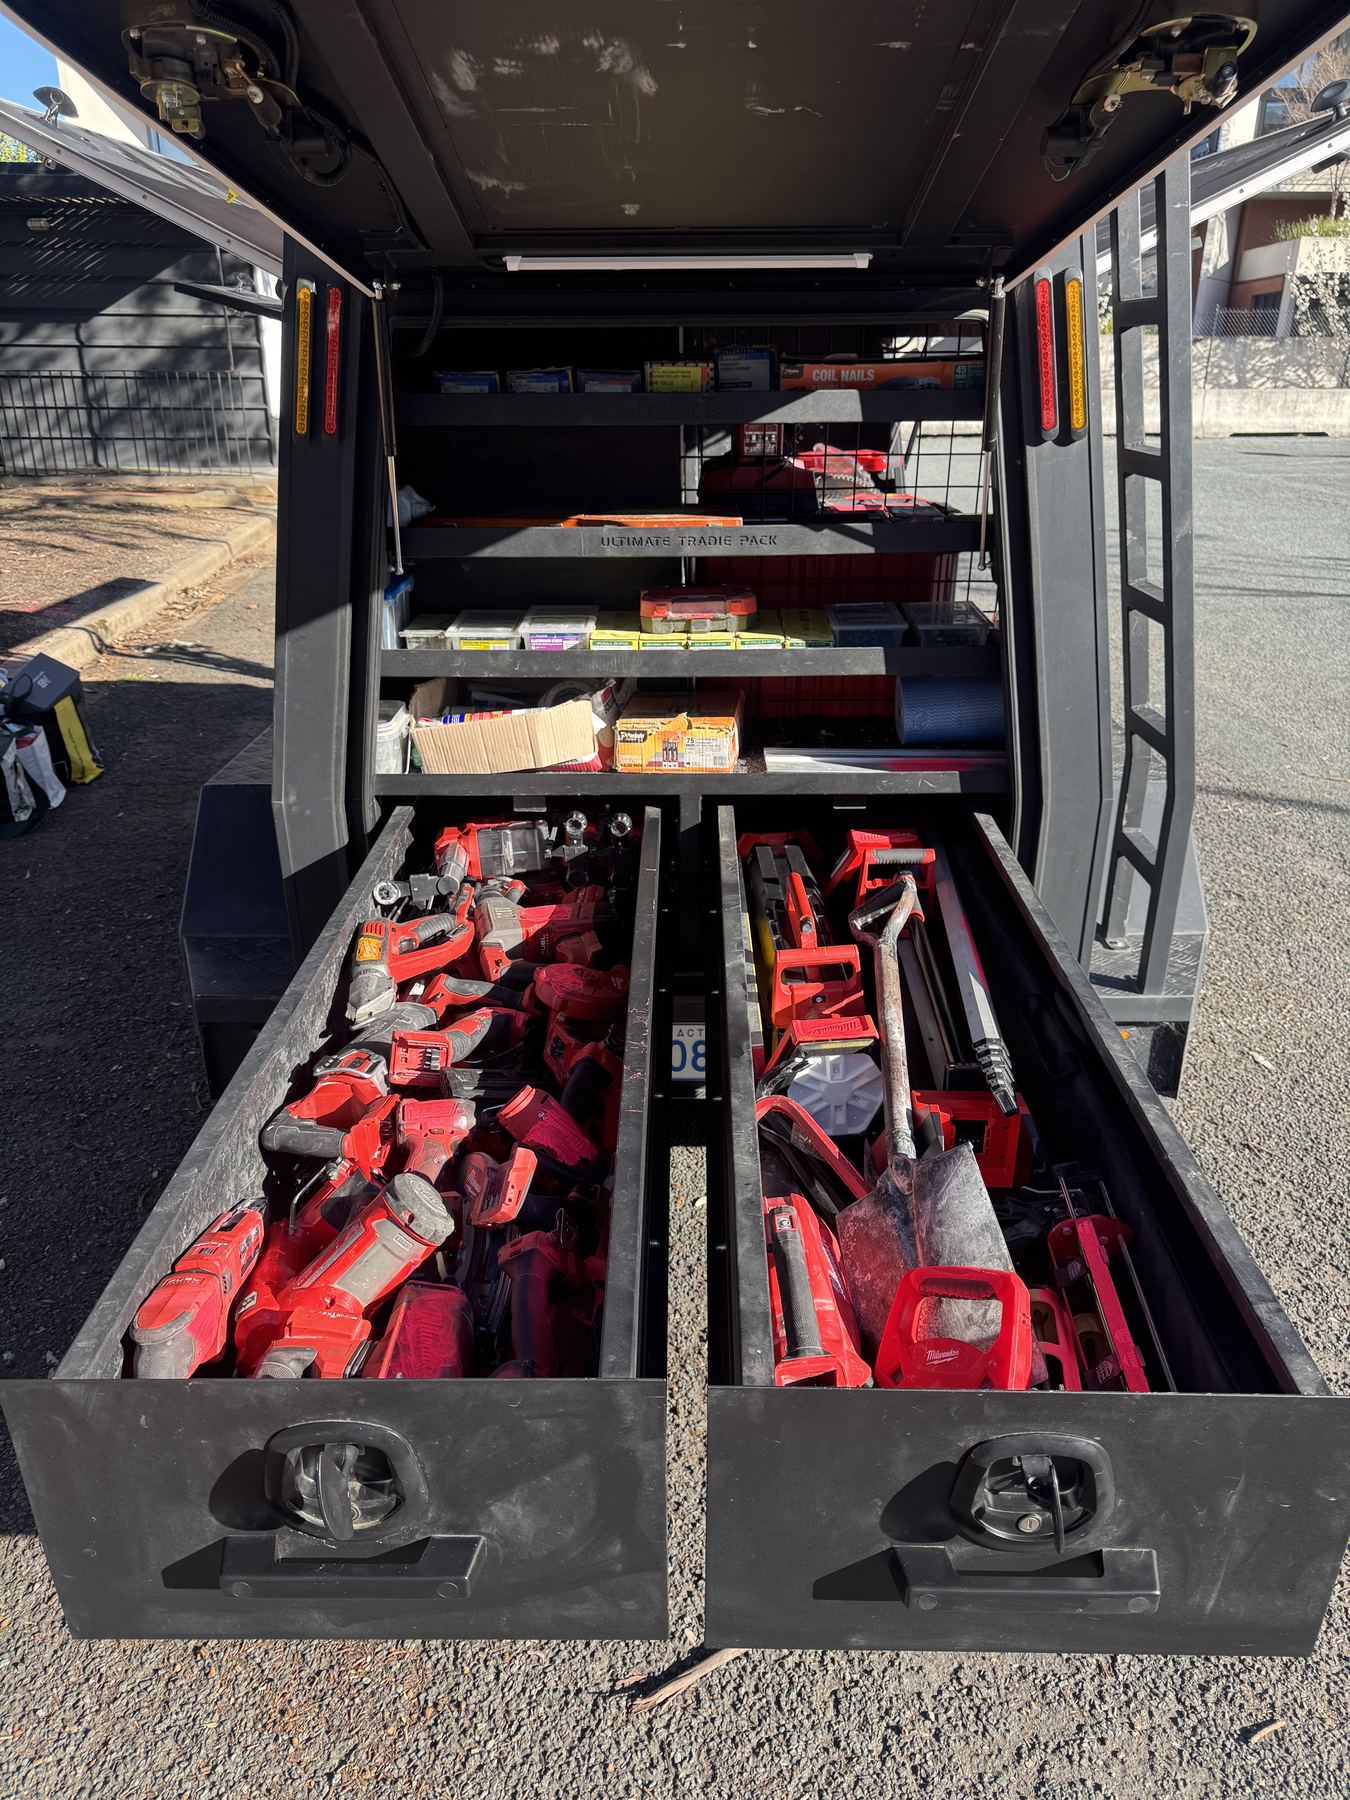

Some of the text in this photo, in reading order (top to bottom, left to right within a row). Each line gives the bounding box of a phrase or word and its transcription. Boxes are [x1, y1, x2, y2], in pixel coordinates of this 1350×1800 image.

[812, 369, 838, 382] COIL
[841, 368, 875, 382] NAILS
[955, 365, 967, 374] 45
[601, 535, 778, 547] ULTIMATE TRADIE PACK
[677, 1028, 705, 1037] ACT
[926, 1348, 961, 1363] Milwaukee
